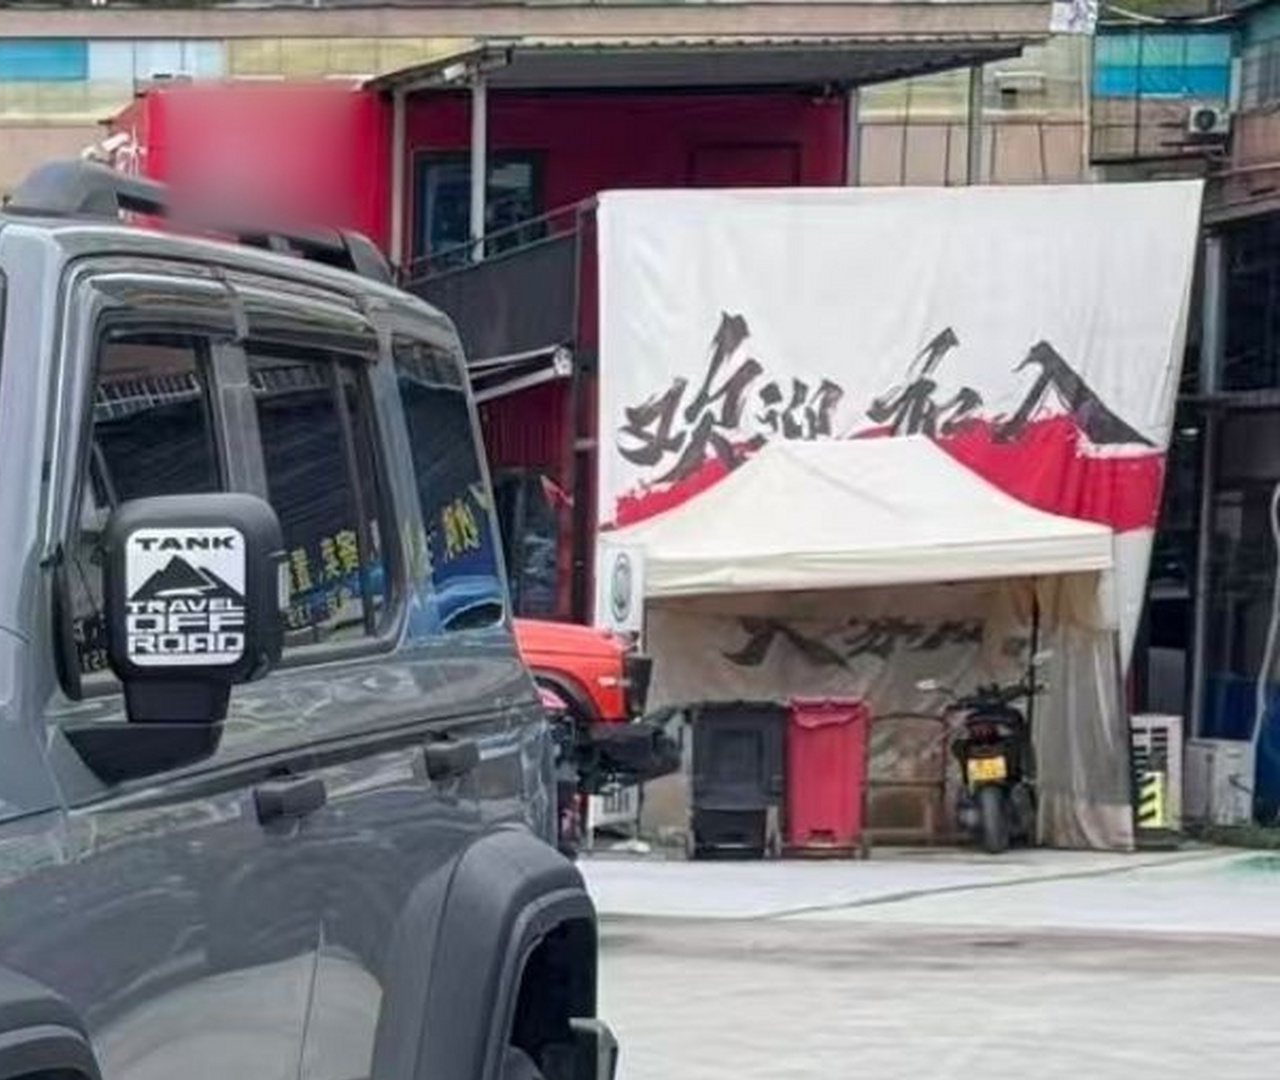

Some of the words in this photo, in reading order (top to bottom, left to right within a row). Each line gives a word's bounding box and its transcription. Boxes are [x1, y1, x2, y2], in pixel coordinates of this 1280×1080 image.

[135, 536, 235, 550] TANK
[126, 598, 244, 613] TRAVEL
[127, 612, 244, 633] OFF
[127, 633, 244, 654] ROAD
